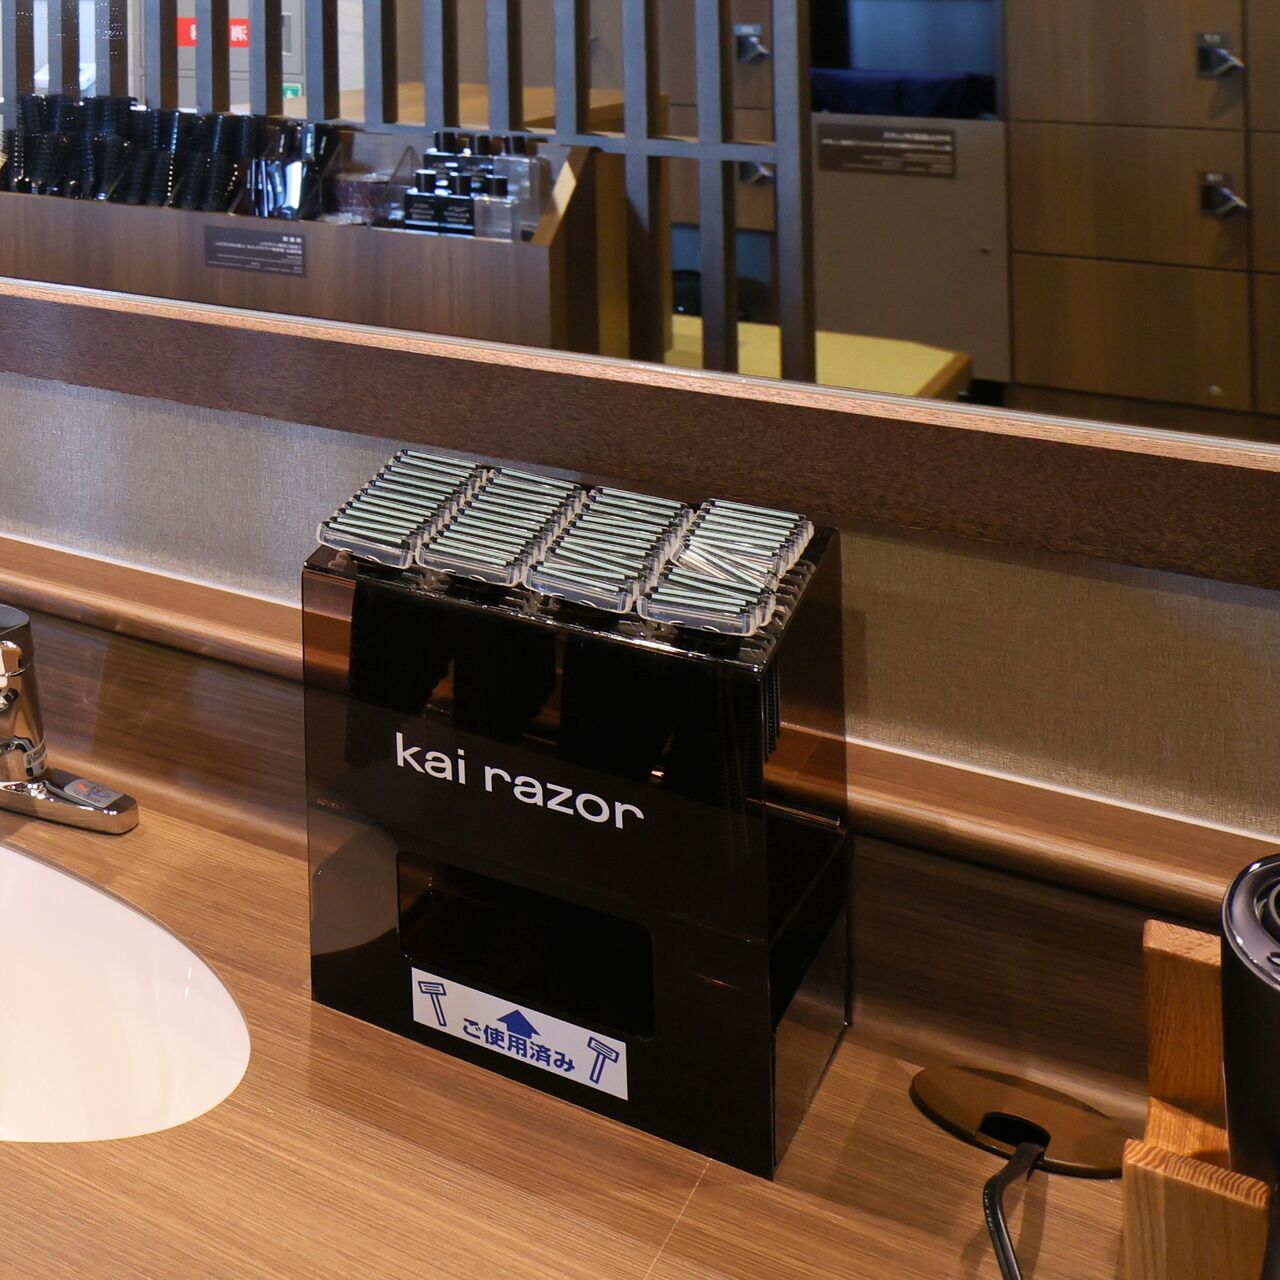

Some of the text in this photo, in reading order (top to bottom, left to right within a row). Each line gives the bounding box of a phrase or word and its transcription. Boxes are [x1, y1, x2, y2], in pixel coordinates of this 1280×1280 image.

[395, 731, 645, 829] kai razor
[463, 1017, 576, 1073] ご使用済み
